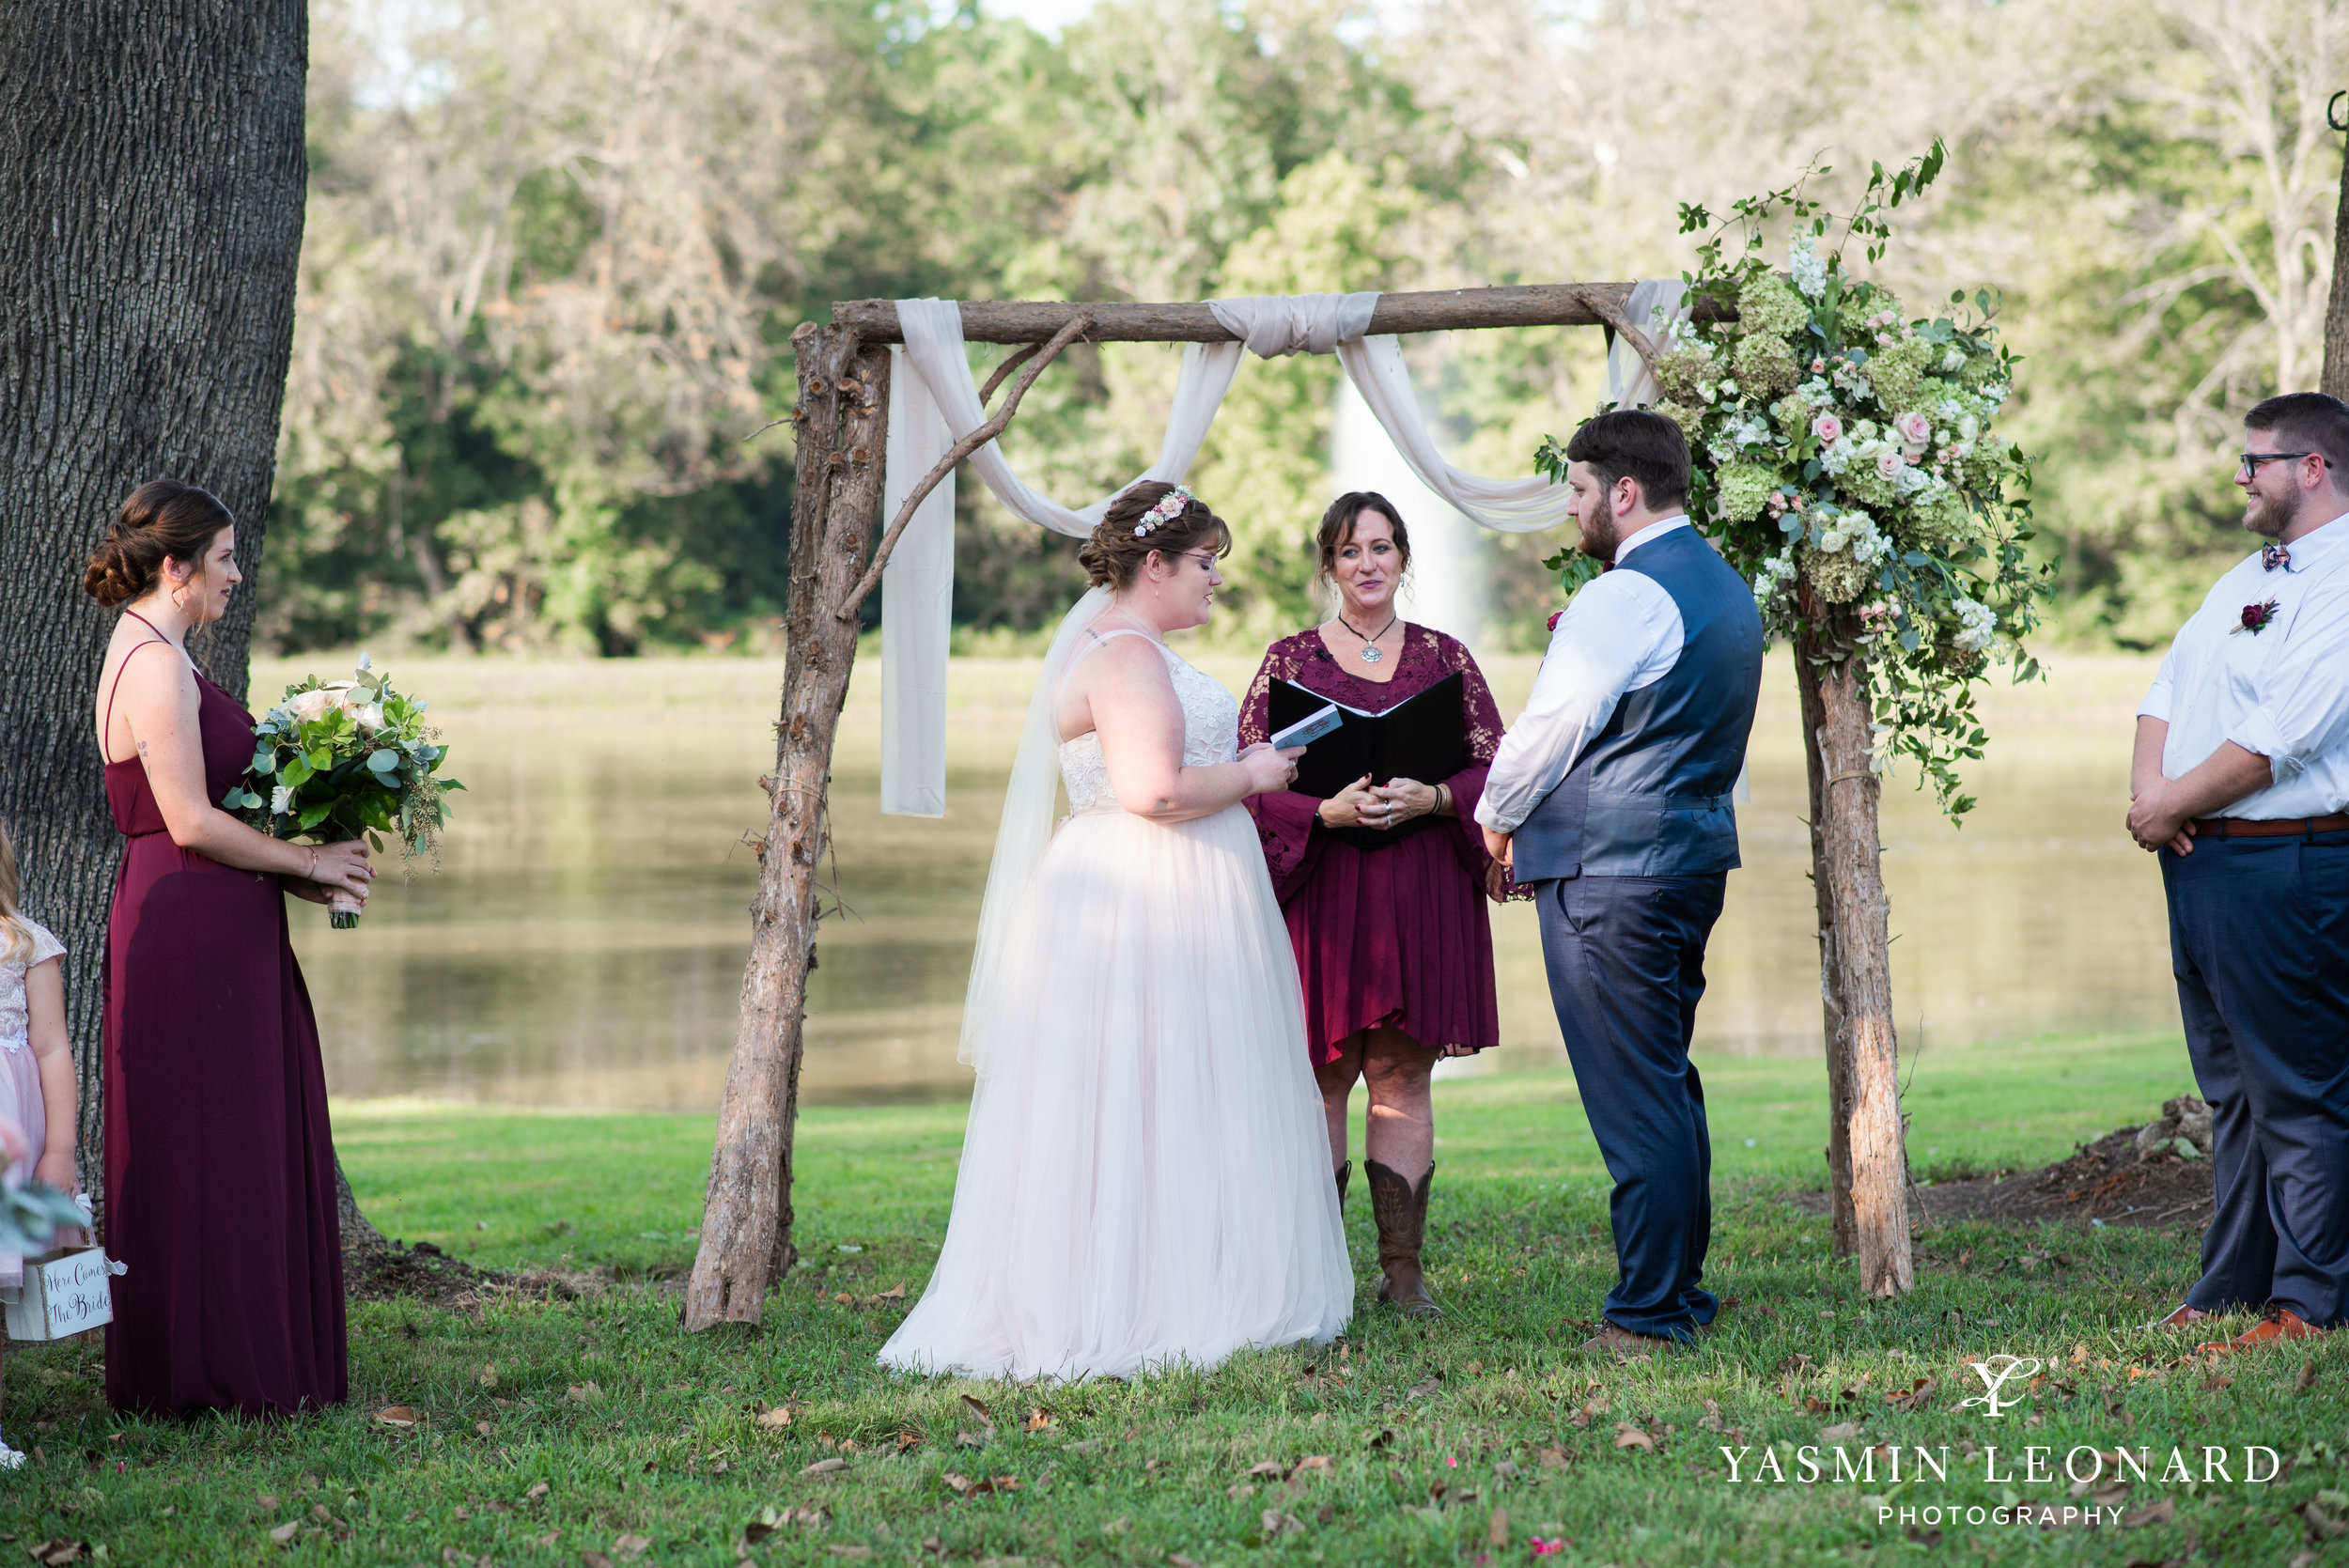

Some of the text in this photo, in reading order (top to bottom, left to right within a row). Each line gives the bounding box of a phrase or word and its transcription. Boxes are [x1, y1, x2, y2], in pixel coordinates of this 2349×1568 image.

[44, 1263, 107, 1293] Here Comes
[48, 1291, 111, 1327] The Bride
